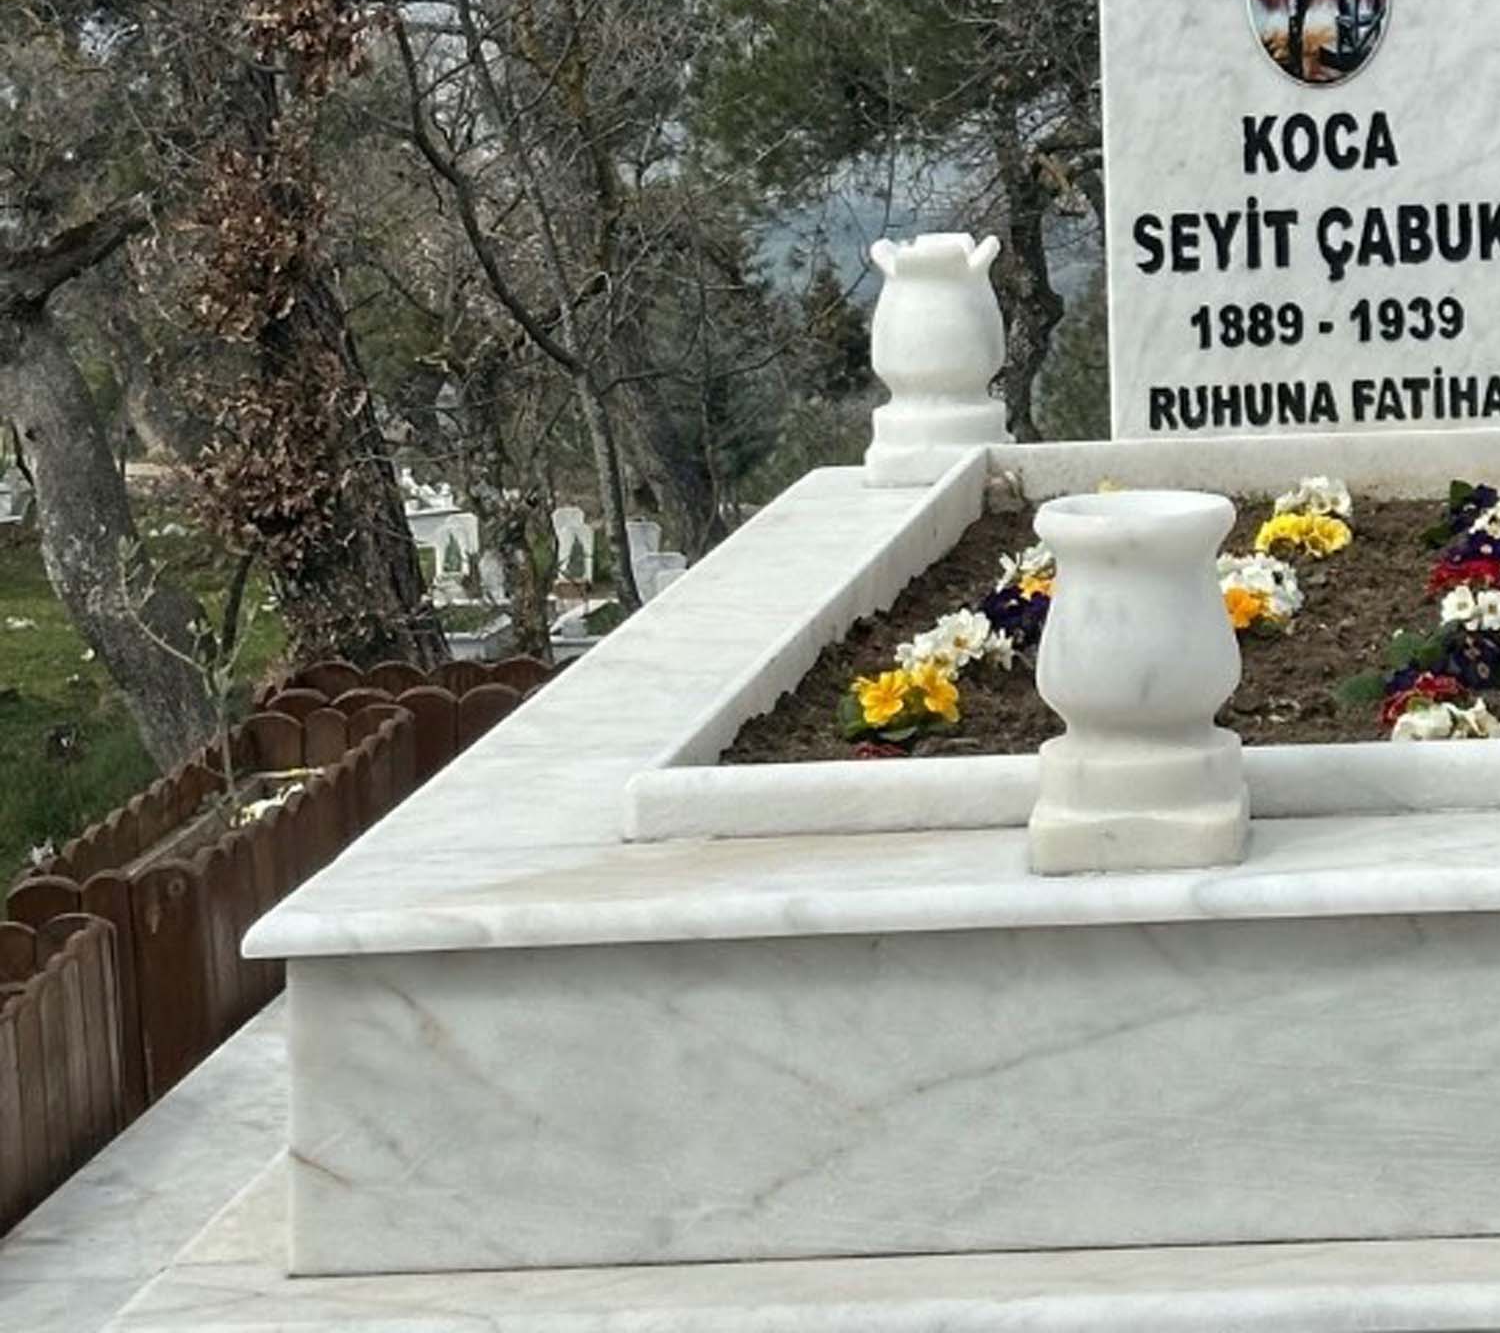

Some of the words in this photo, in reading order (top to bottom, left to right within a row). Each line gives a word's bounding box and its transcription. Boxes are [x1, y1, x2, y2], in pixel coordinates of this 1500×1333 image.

[1243, 112, 1398, 174] KOCA
[1133, 196, 1298, 274] SEYİT
[1191, 303, 1303, 349] 1889
[1319, 322, 1333, 333] -
[1350, 297, 1463, 342] 1939
[1150, 381, 1339, 430] RUHUNA
